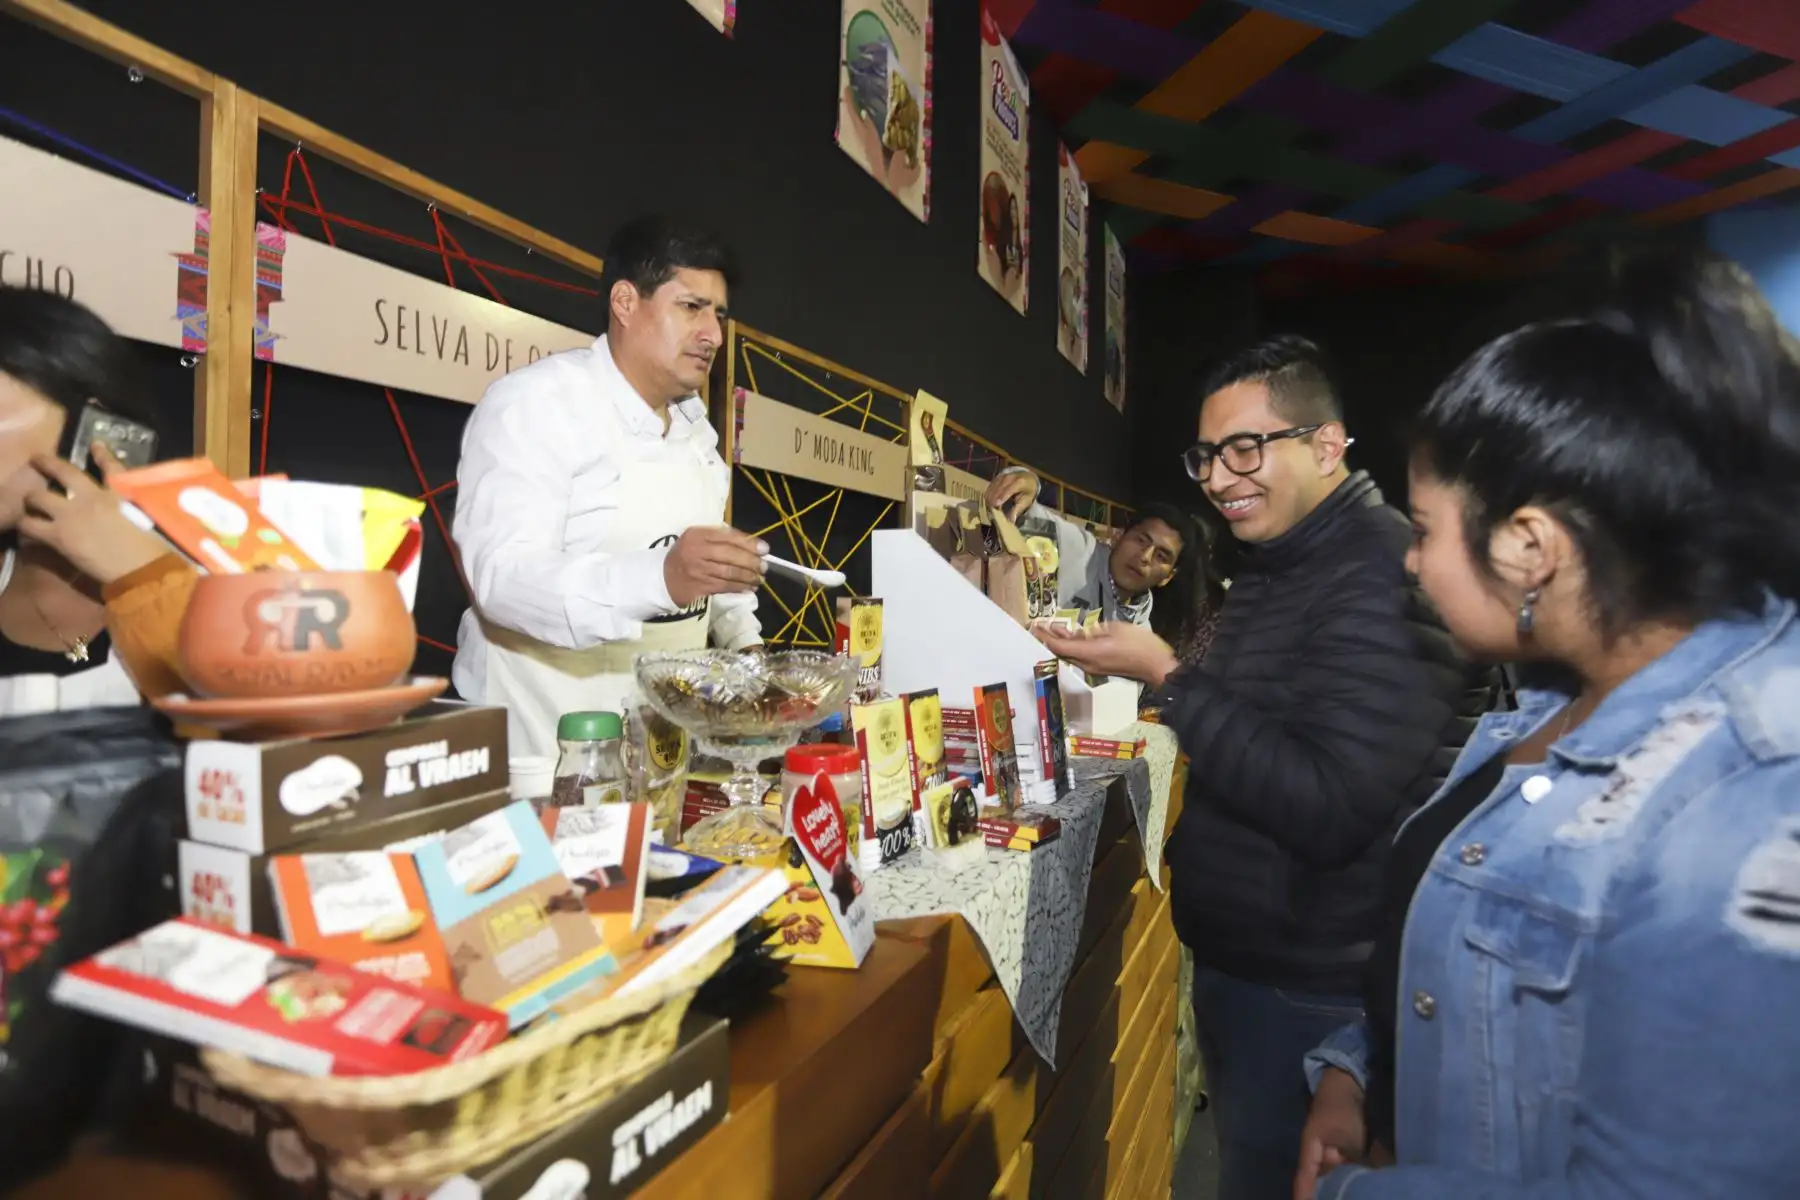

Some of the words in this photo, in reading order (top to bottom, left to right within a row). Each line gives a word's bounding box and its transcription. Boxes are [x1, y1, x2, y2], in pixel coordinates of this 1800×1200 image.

[374, 298, 469, 367] SELVA
[813, 434, 845, 467] MODA
[848, 445, 875, 476] KING
[384, 764, 416, 798] AL
[418, 746, 490, 789] VRAEM
[801, 798, 835, 833] Lovely
[810, 815, 841, 853] heart
[880, 826, 911, 858] 100%
[609, 1135, 642, 1186] AL
